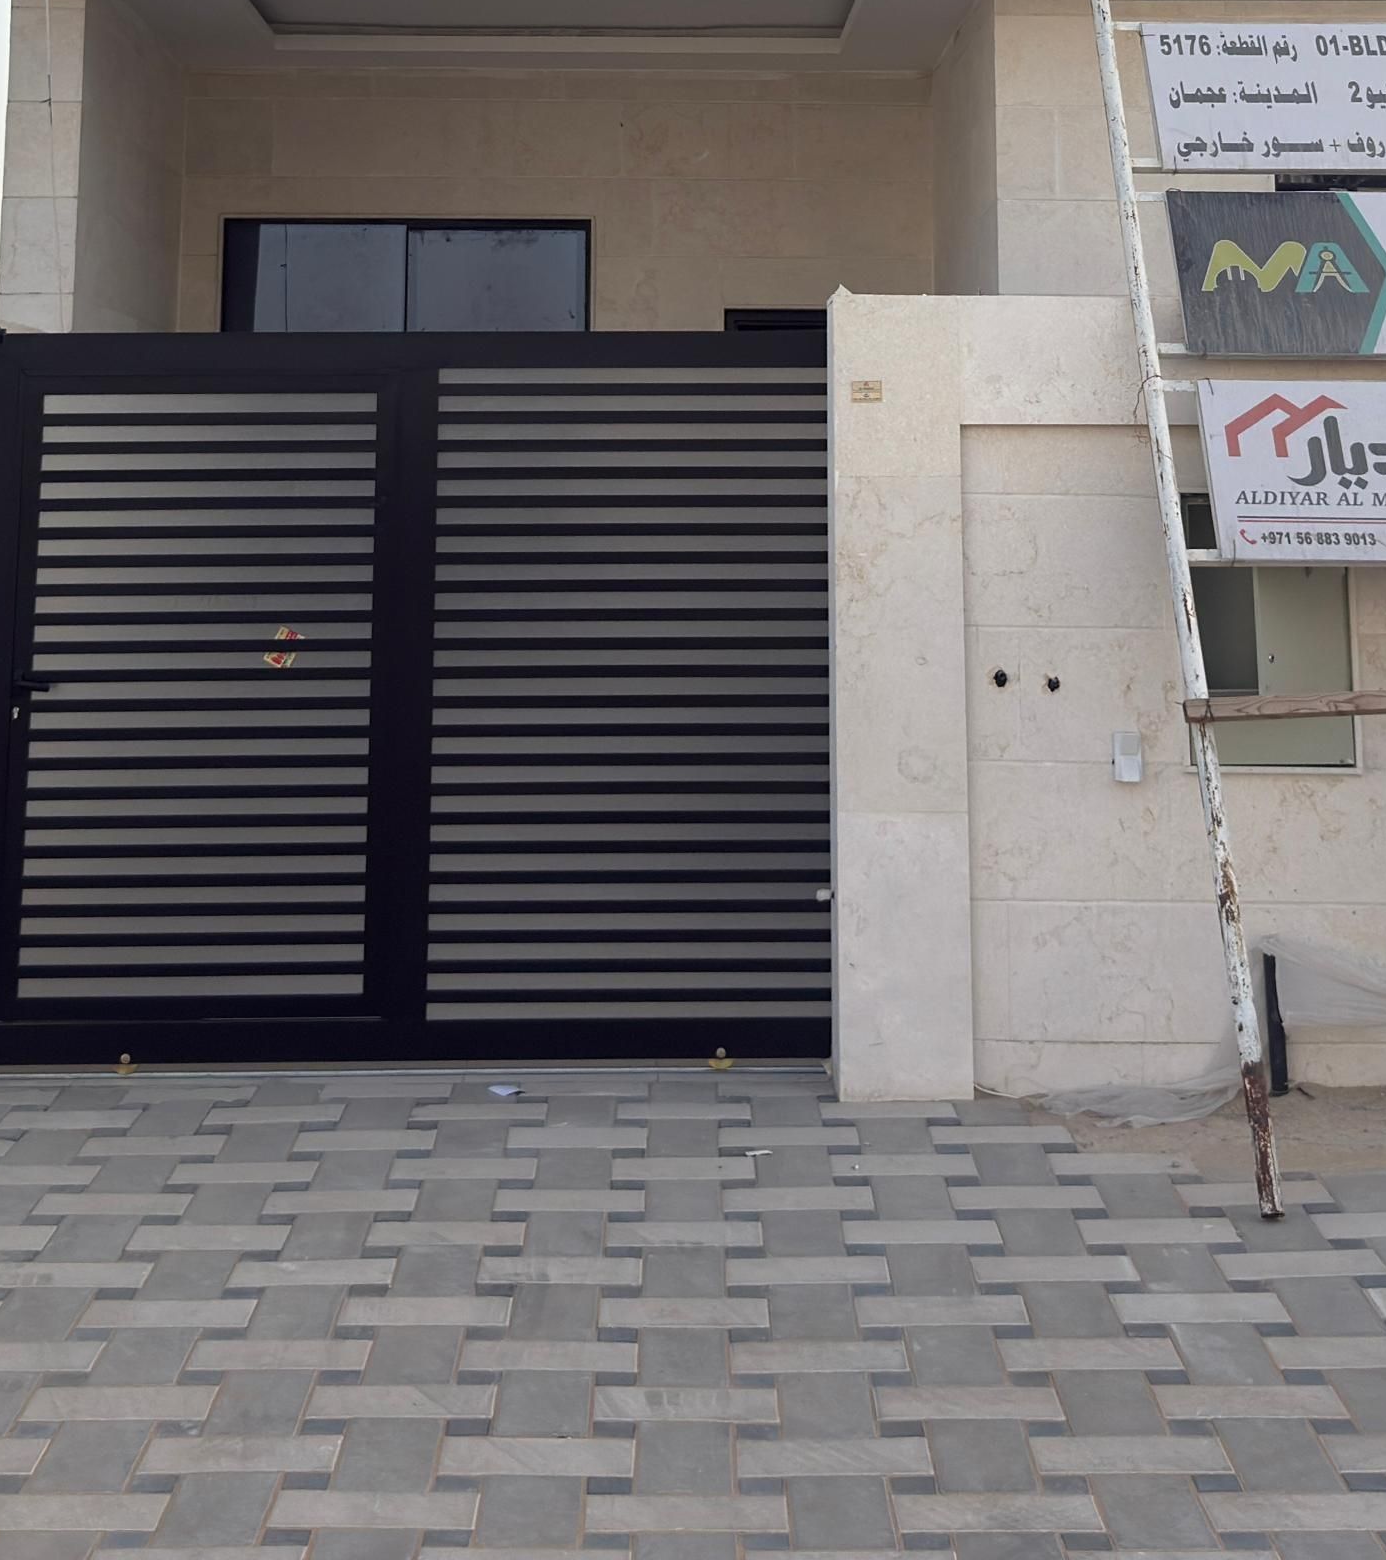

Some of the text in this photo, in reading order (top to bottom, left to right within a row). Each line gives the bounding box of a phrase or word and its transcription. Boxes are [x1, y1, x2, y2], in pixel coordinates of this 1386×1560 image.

[1160, 34, 1212, 56] 5176
[1216, 32, 1269, 57] القطعة:
[1272, 34, 1298, 64] رقم
[1169, 81, 1227, 109] عجمان
[1233, 81, 1318, 109] المدينة:
[1177, 130, 1255, 162] خارجي
[1262, 134, 1325, 159] سور
[1347, 130, 1386, 158] روف
[1235, 490, 1329, 506] ALDIYAR
[1336, 493, 1363, 507] AL
[1260, 531, 1377, 547] +971 56 883 9013
